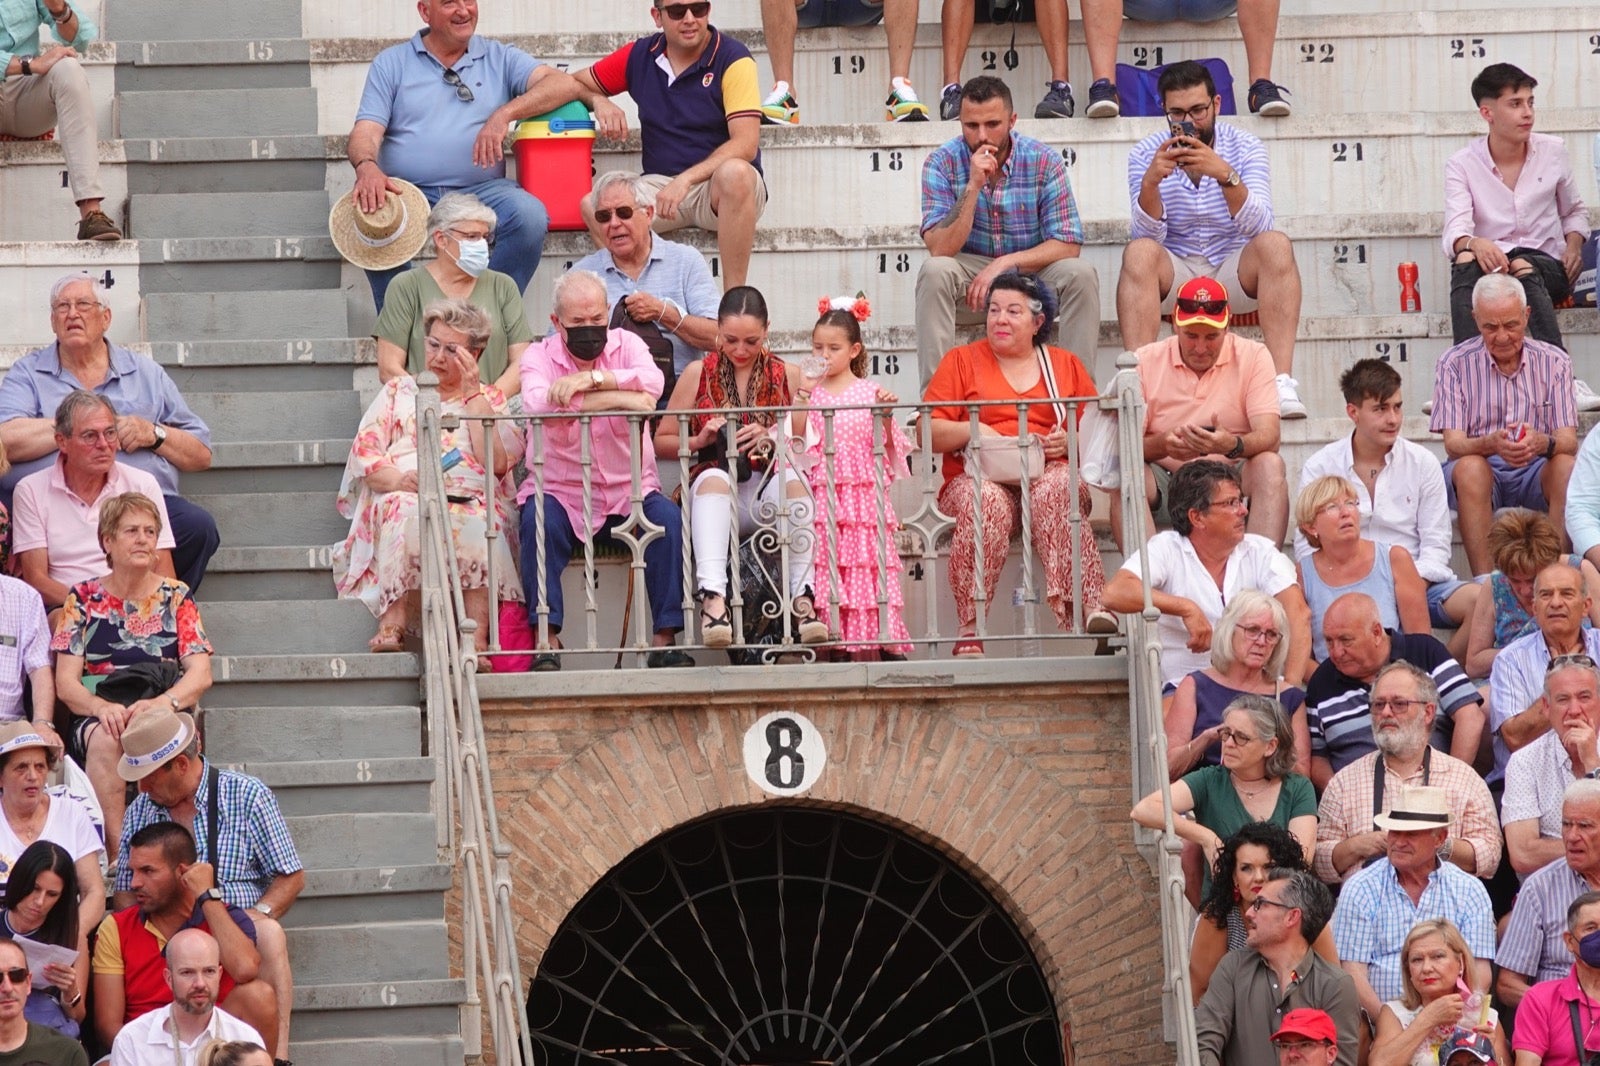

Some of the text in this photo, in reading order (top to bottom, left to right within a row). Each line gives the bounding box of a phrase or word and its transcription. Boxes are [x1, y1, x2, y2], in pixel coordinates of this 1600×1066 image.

[246, 41, 273, 61] 15
[1133, 47, 1163, 66] 21
[1300, 44, 1334, 63] 22
[832, 55, 865, 75] 19
[249, 139, 278, 159] 14
[1332, 142, 1363, 162] 21
[870, 152, 903, 172] 18
[877, 253, 910, 273] 18
[1334, 244, 1367, 263] 21
[284, 340, 313, 361] 12
[1376, 343, 1408, 362] 21
[870, 355, 900, 375] 18
[295, 443, 320, 463] 11
[306, 548, 334, 569] 10
[330, 657, 347, 679] 9
[151, 743, 175, 762] asisa
[764, 717, 805, 789] 8
[357, 760, 372, 782] 8
[379, 869, 396, 890] 7
[381, 984, 397, 1006] 6
